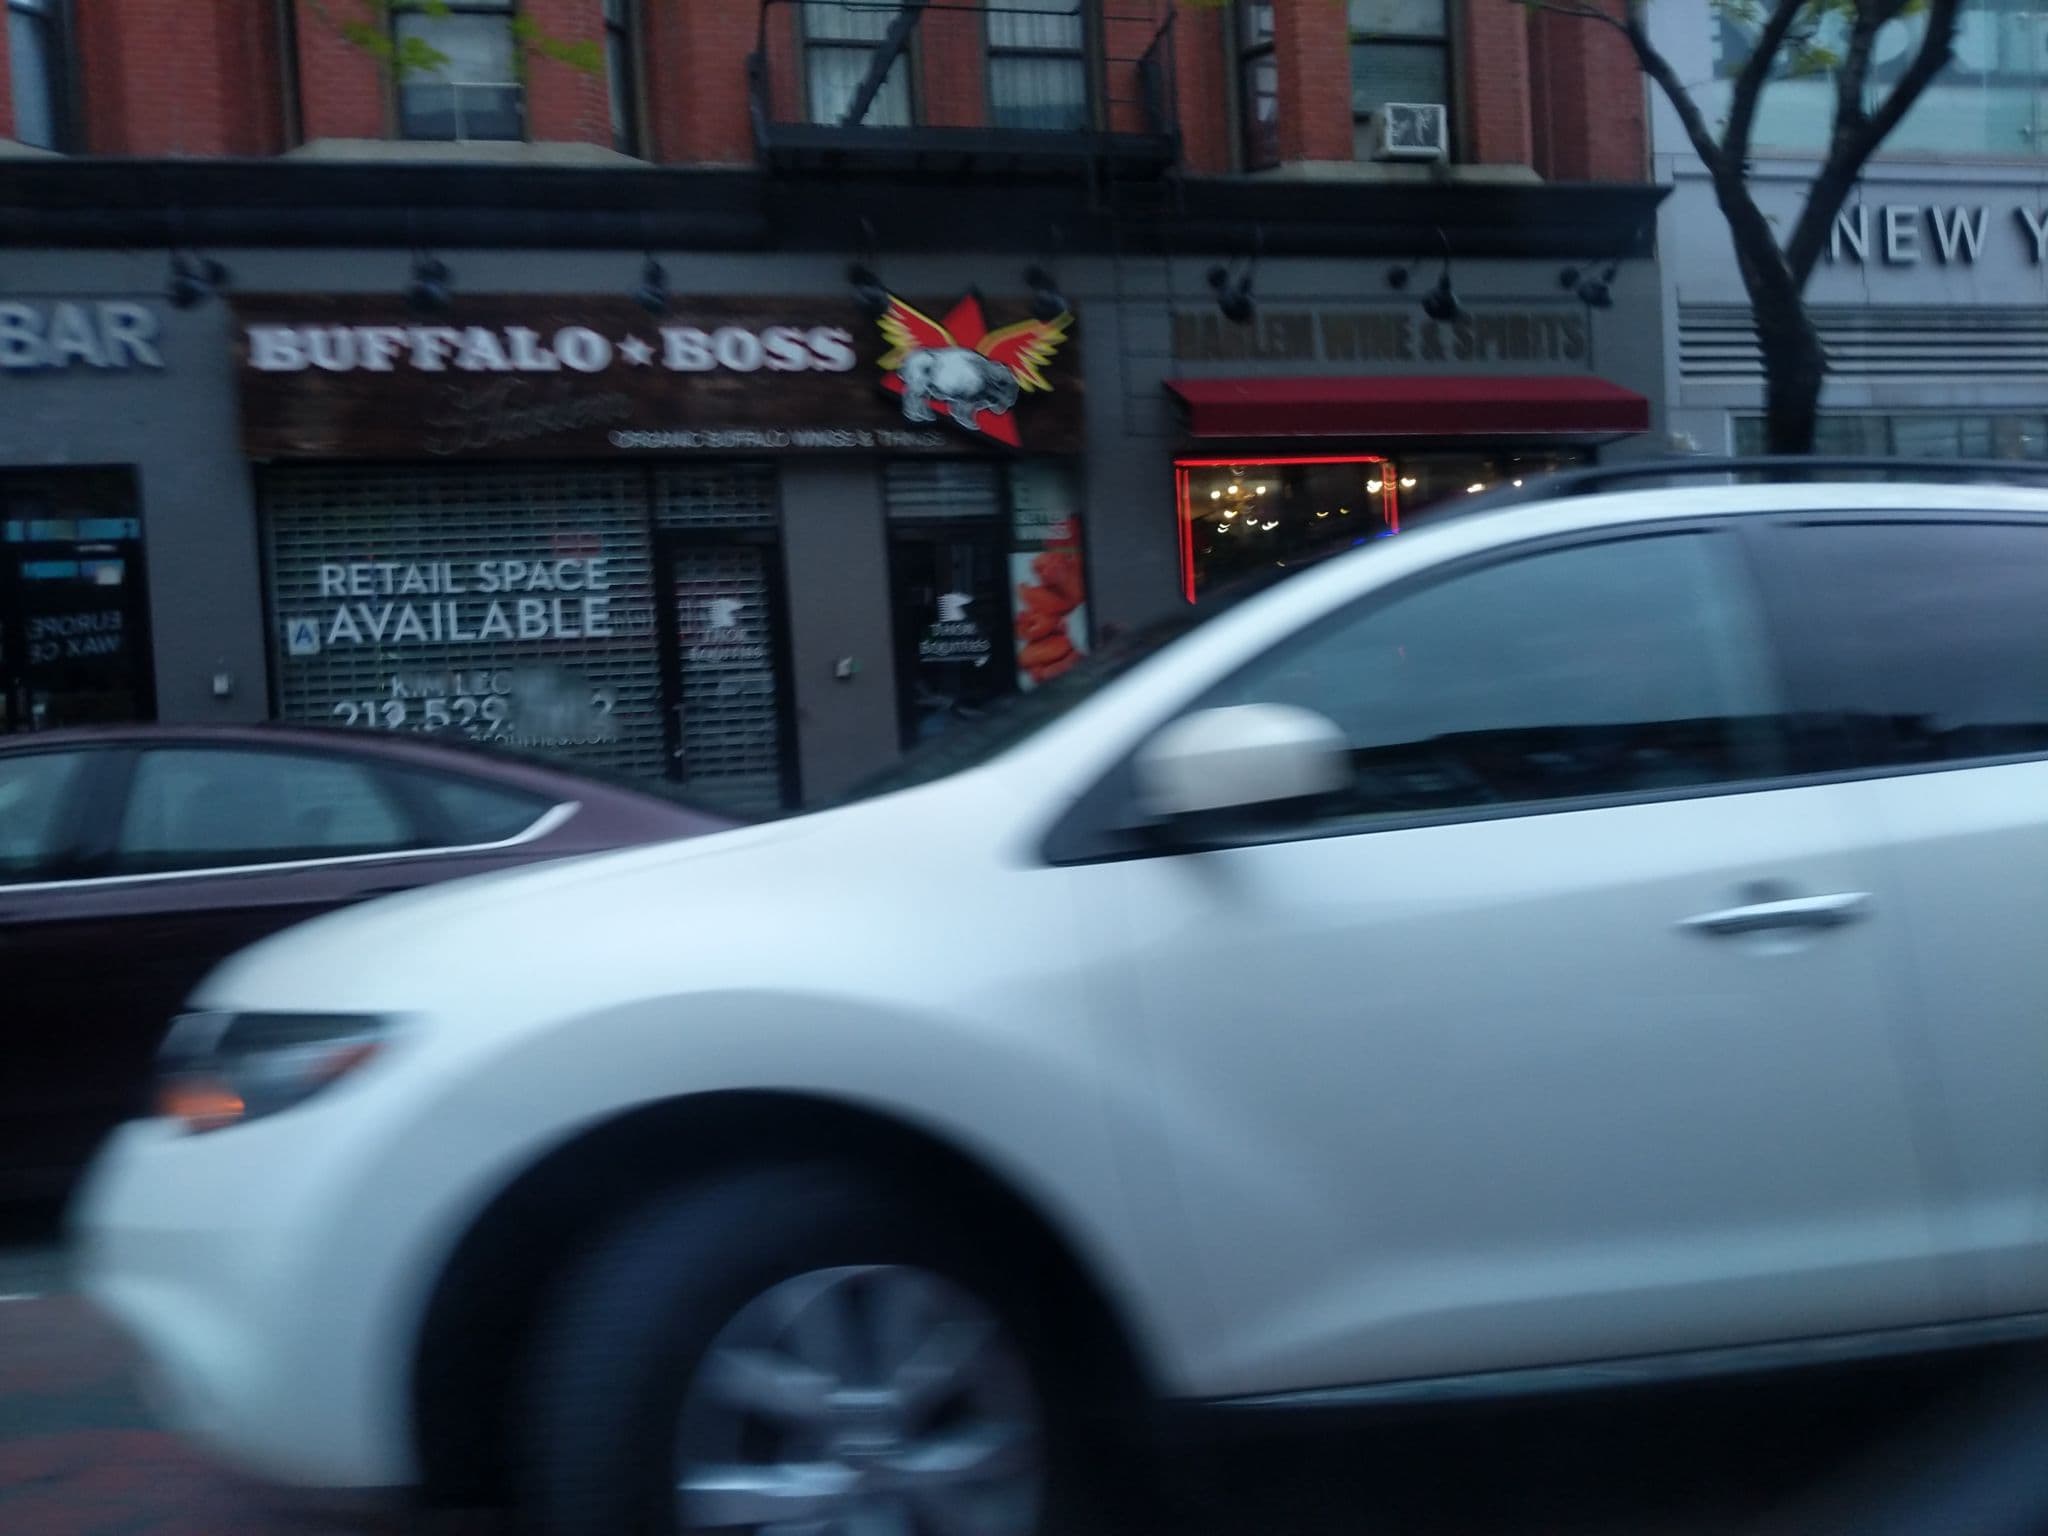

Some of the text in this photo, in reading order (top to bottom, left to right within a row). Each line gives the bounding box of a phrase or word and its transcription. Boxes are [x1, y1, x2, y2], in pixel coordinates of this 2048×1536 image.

[1830, 203, 1989, 262] NEW
[0, 301, 166, 369] BAR
[246, 325, 858, 373] BUFFALO BOSS
[321, 557, 611, 597] RETAIL SPACE
[326, 596, 614, 645] AVAILABLE
